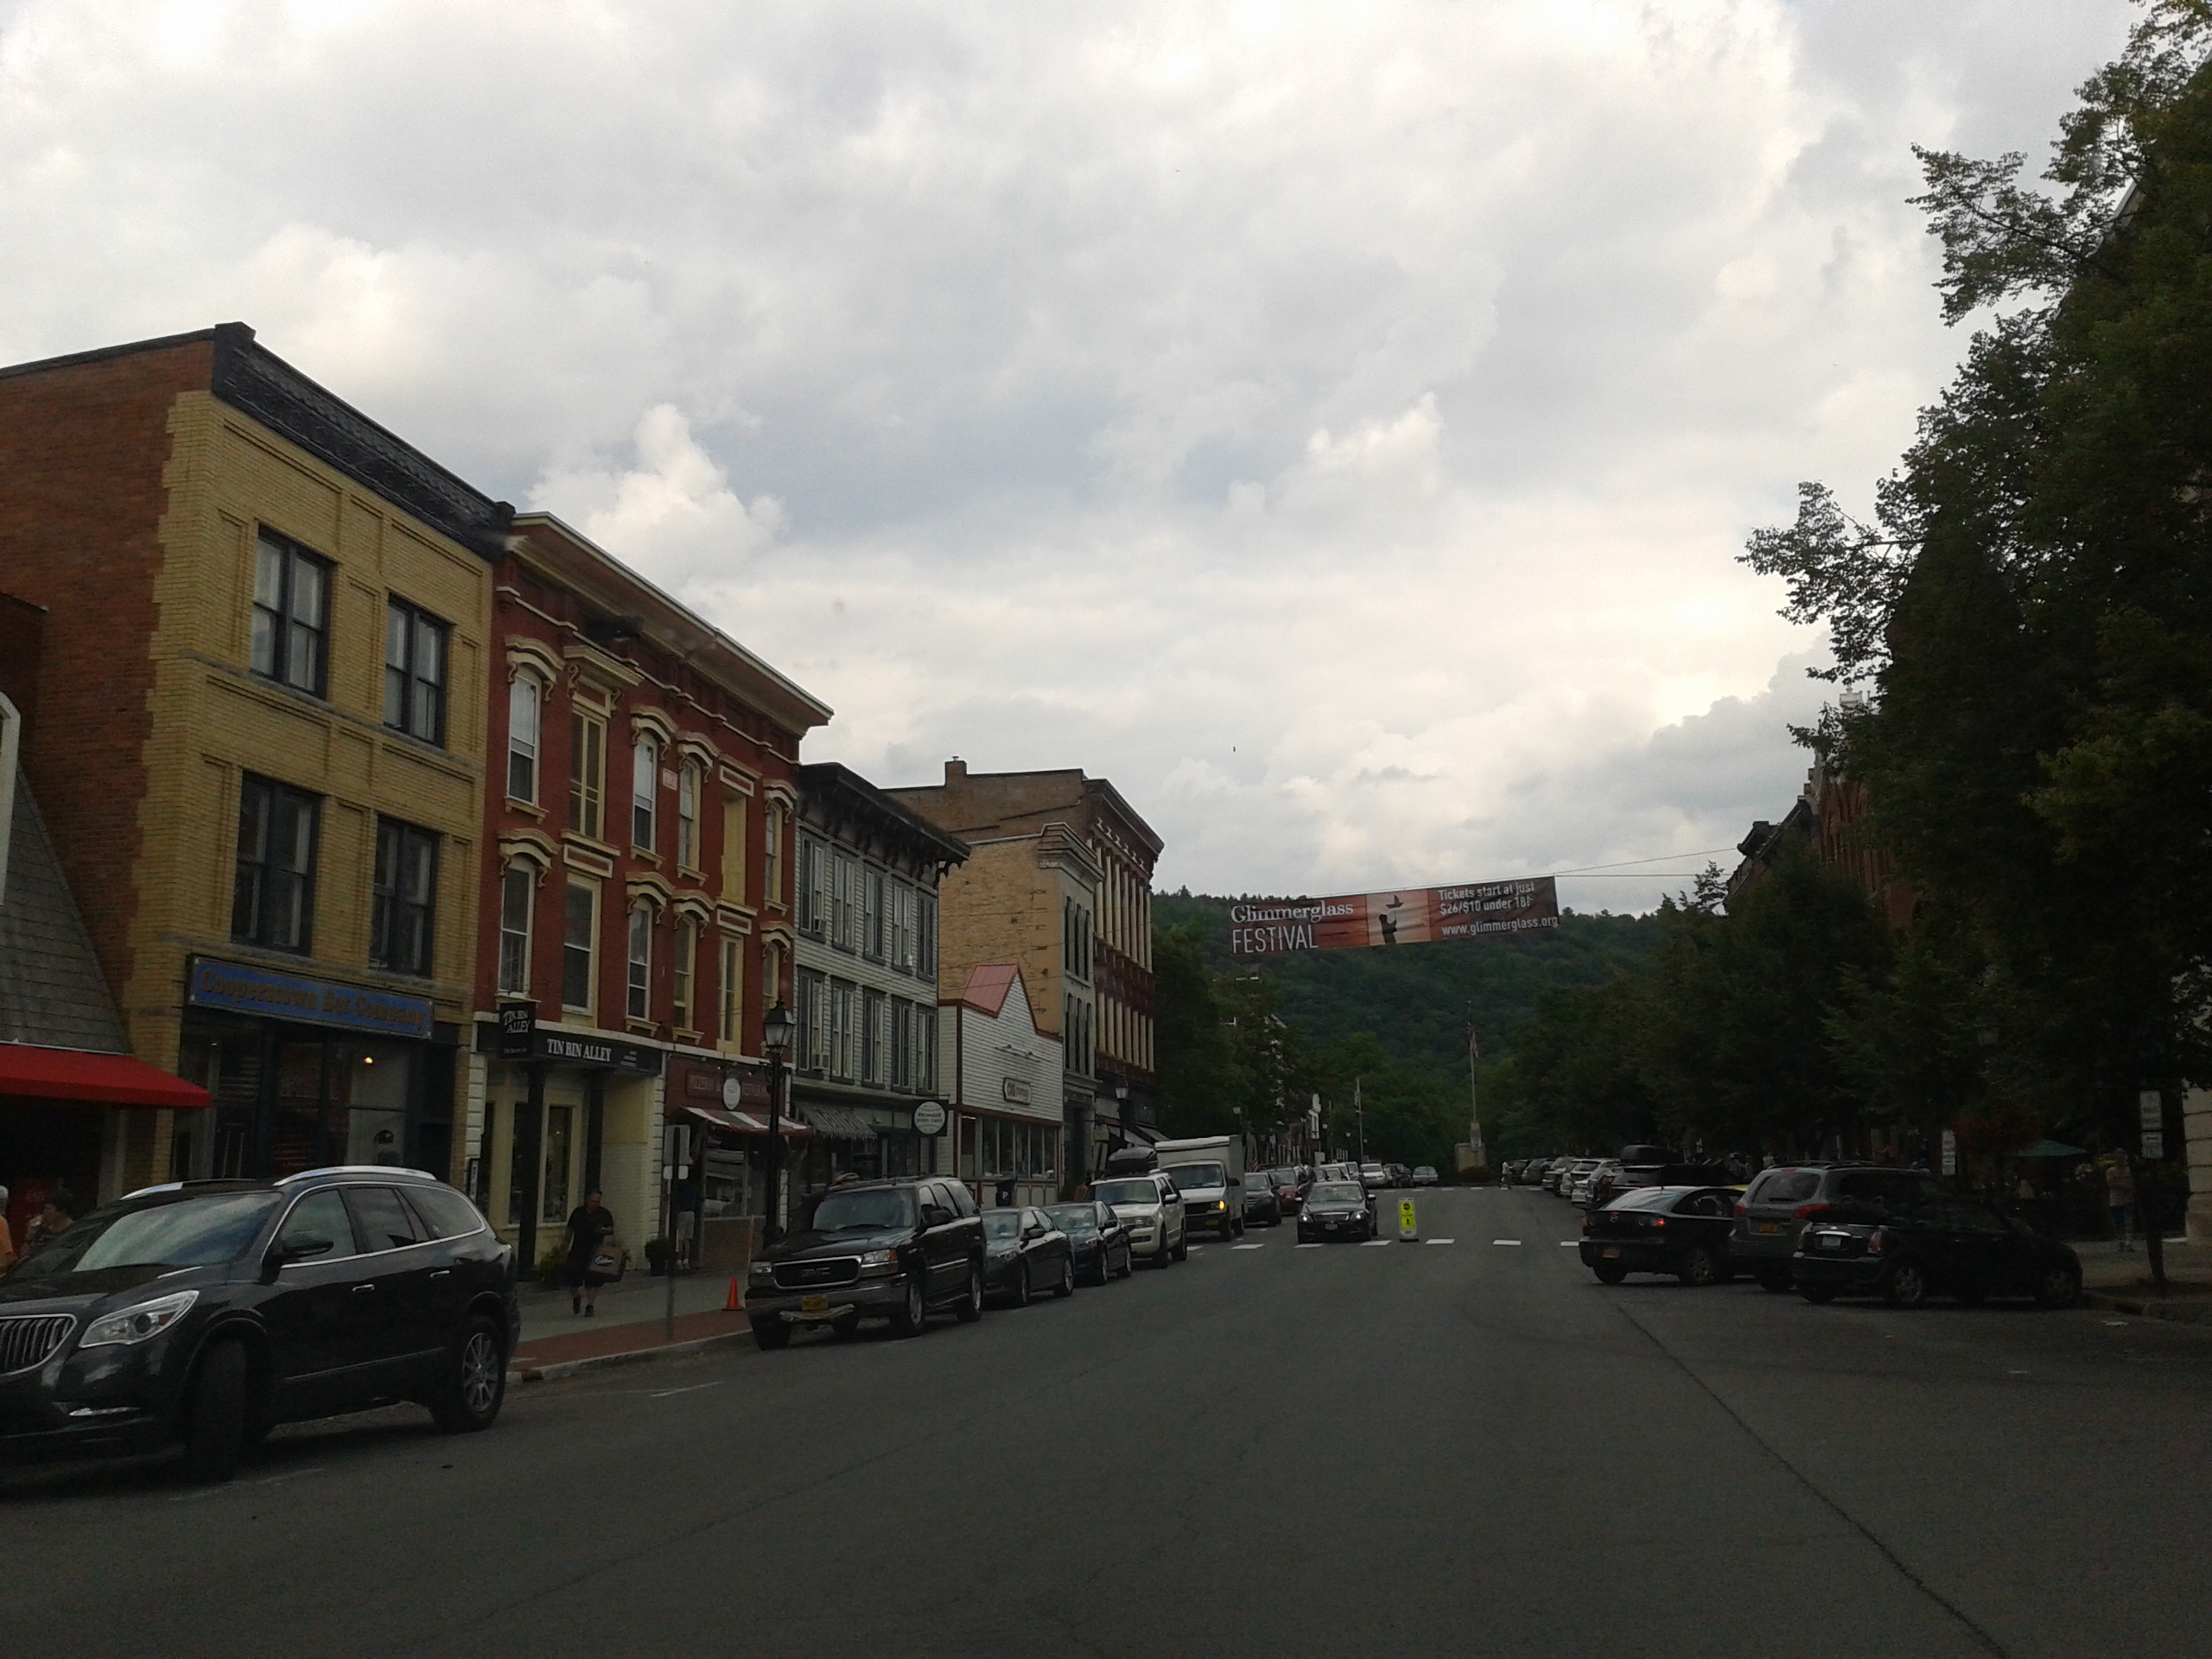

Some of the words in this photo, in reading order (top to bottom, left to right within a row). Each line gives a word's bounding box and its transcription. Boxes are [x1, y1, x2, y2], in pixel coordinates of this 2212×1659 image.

[1438, 888, 1475, 901] Tickets
[1477, 885, 1502, 898] start
[1503, 884, 1514, 895] at
[1515, 881, 1535, 896] just
[1230, 899, 1355, 924] Glimmerglass
[1440, 899, 1482, 916] $26/$10
[1483, 899, 1512, 911] under
[1441, 916, 1559, 936] www.glimmerglass.org
[1232, 925, 1319, 954] FESTIVAL
[201, 968, 318, 1011] Cooperstown
[355, 994, 425, 1031] Company
[505, 1020, 532, 1034] ALLEY
[547, 1038, 564, 1055] TIN
[565, 1041, 583, 1058] BIN
[582, 1044, 613, 1063] ALLEY
